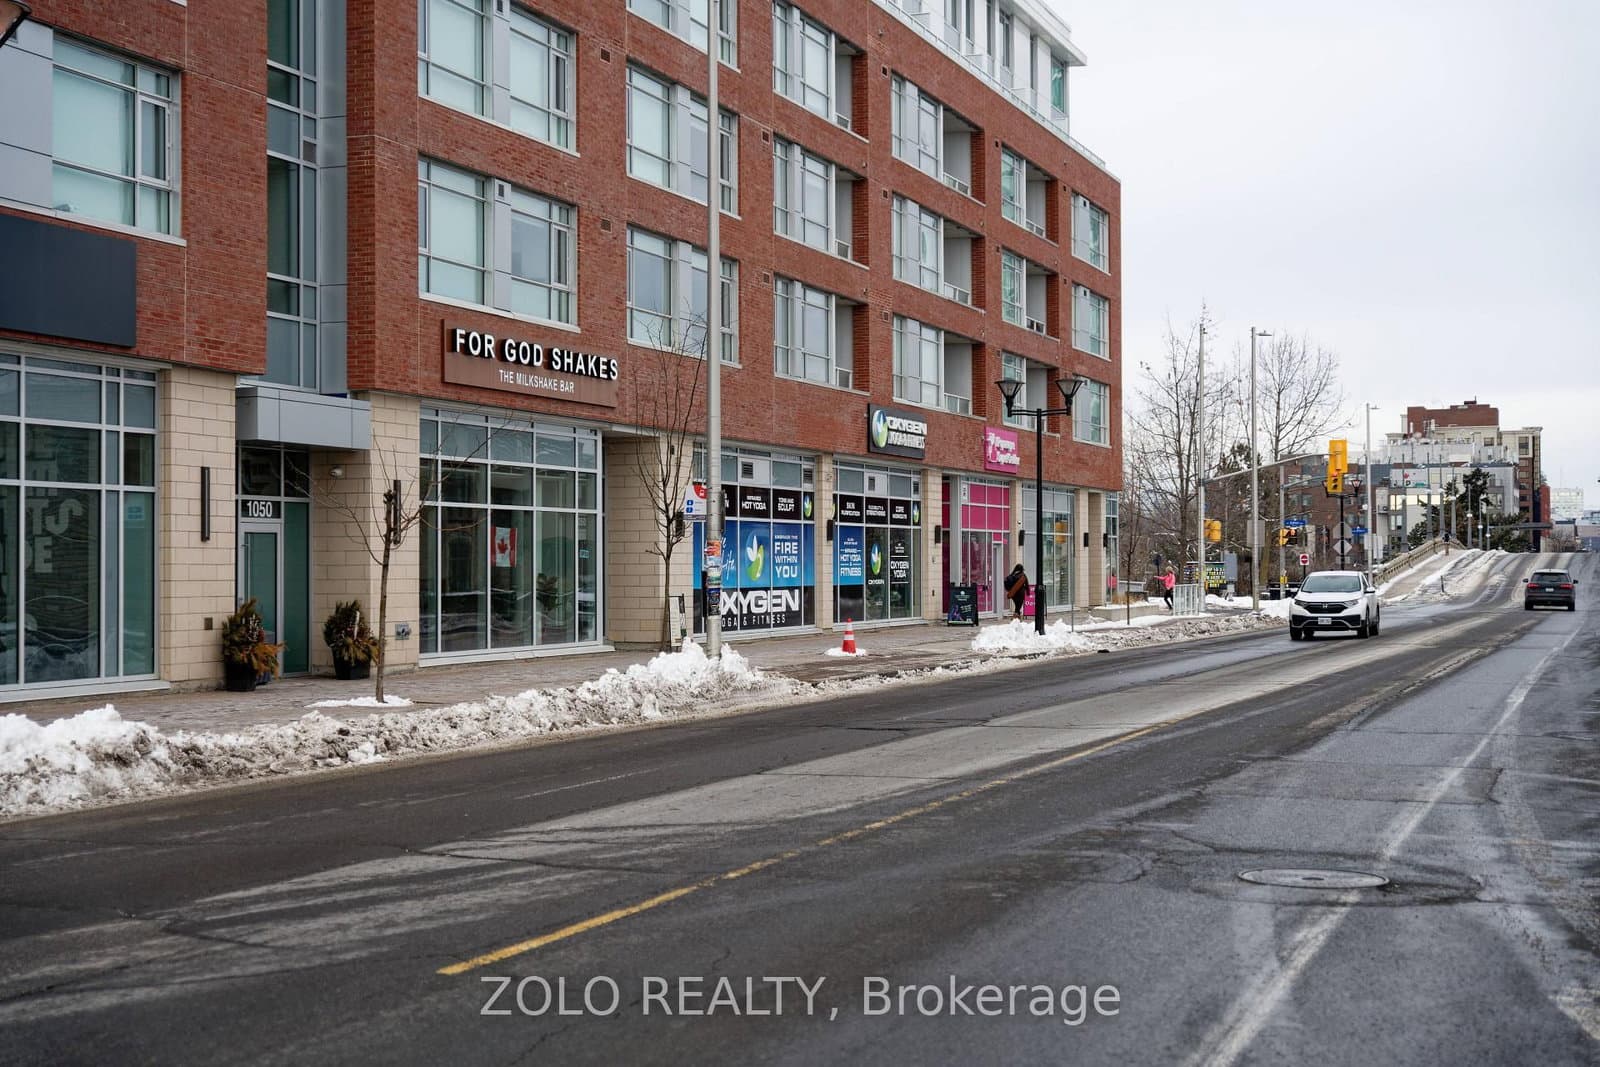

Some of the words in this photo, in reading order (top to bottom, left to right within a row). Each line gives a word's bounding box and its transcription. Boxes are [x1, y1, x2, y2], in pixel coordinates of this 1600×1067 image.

[455, 328, 496, 359] FOR
[504, 338, 544, 367] GOD
[551, 347, 618, 381] SHAKES
[499, 369, 514, 384] THE
[516, 372, 558, 391] MILKSHAKE
[559, 381, 575, 394] BAR
[246, 500, 273, 517] 1050
[774, 541, 798, 554] FIRE
[774, 555, 797, 563] WITHIN
[775, 565, 798, 578] YOU
[720, 589, 800, 615] XYGEN
[720, 617, 738, 628] OGA
[752, 614, 786, 625] FITNESS
